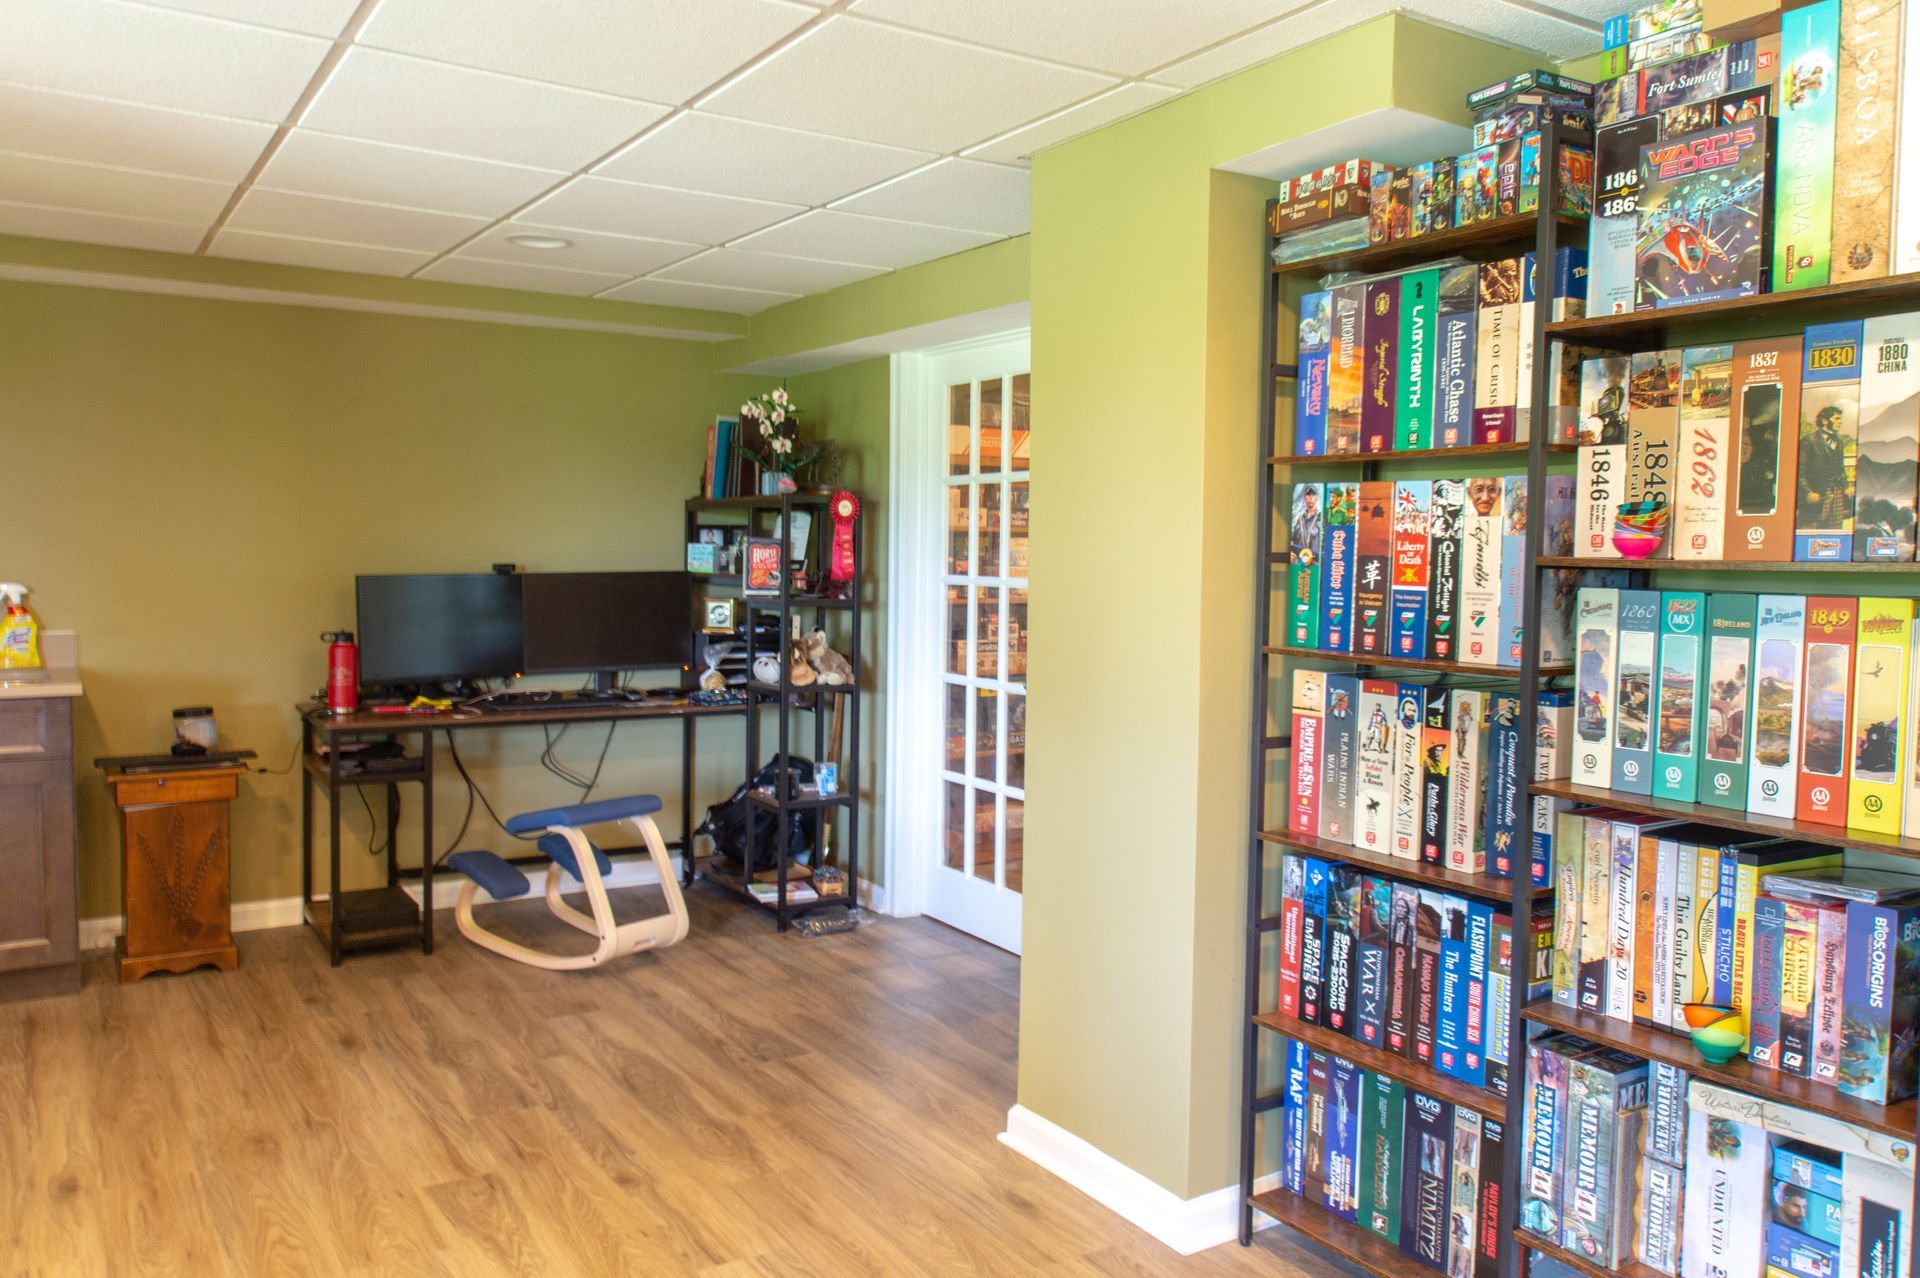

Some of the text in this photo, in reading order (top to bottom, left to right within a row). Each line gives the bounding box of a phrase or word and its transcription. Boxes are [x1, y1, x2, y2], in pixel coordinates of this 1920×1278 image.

[1648, 69, 1723, 97] Fort Sumter
[1855, 7, 1879, 146] LISBOA
[1648, 127, 1756, 165] WARP'S
[1659, 146, 1740, 180] EDGE
[1603, 197, 1639, 217] 186
[1793, 174, 1813, 236] NOVA
[1573, 268, 1587, 279] Th
[1492, 307, 1503, 338] TIME
[1409, 305, 1424, 408] LABYRINTH
[1448, 320, 1467, 424] Atlantic Chase
[1491, 344, 1500, 362] OF
[1749, 351, 1779, 368] 1837
[1812, 347, 1853, 368] 1830
[1877, 360, 1908, 374] CHINA
[1878, 343, 1909, 362] 1880
[1490, 366, 1500, 405] CRISIS
[1590, 449, 1611, 501] 1846
[1630, 429, 1643, 499] Austral
[1691, 428, 1717, 498] 1862
[1397, 541, 1425, 553] Liberty
[1399, 555, 1422, 565] Death
[1443, 541, 1455, 575] Colonial
[1362, 559, 1382, 590] 革
[1622, 604, 1656, 618] 1860
[1667, 599, 1698, 613] 1822
[1671, 615, 1690, 625] MX
[1810, 609, 1850, 625] 1849
[1327, 754, 1335, 784] WARS
[1338, 732, 1348, 808] PLAINS INDIAN
[1400, 733, 1416, 806] For People
[1505, 732, 1519, 778] Conquest
[1457, 761, 1470, 847] Wilderness War
[1504, 783, 1517, 826] Paradise
[1537, 795, 1549, 832] EAKS
[1613, 863, 1631, 981] Hundred Days 20
[1677, 896, 1690, 924] This
[1302, 917, 1314, 982] EMPIRES
[1469, 915, 1486, 980] FLASHPOINT
[1674, 928, 1689, 970] Guilty
[1735, 918, 1747, 949] BRAVE
[1308, 938, 1321, 985] SPACE
[1339, 934, 1351, 1012] SPACECORP
[1361, 950, 1378, 995] WAR
[1719, 928, 1732, 982] STILICHO
[1734, 950, 1745, 979] LITTLE
[1870, 916, 1889, 1008] BIOS:ORIGINS
[1419, 953, 1433, 1024] NAVAJO WARS
[1443, 951, 1459, 1013] The Hunters
[1673, 973, 1687, 1005] Land
[1466, 982, 1482, 1044] SOUTH CHINA SEA
[1290, 1067, 1303, 1106] RAF
[1415, 1094, 1441, 1111] DVG
[1618, 1081, 1648, 1108] ME
[1533, 1083, 1557, 1173] MEMOIR
[1655, 1083, 1673, 1153] MEMOIR
[1577, 1102, 1599, 1194] MEMOIR
[1419, 1178, 1439, 1260] NIMITZ
[1648, 1192, 1666, 1261] MEMOIR
[1711, 1170, 1726, 1255] UNDAUNTED
[1826, 1203, 1840, 1220] PA
[1486, 1225, 1497, 1259] HOUSE
